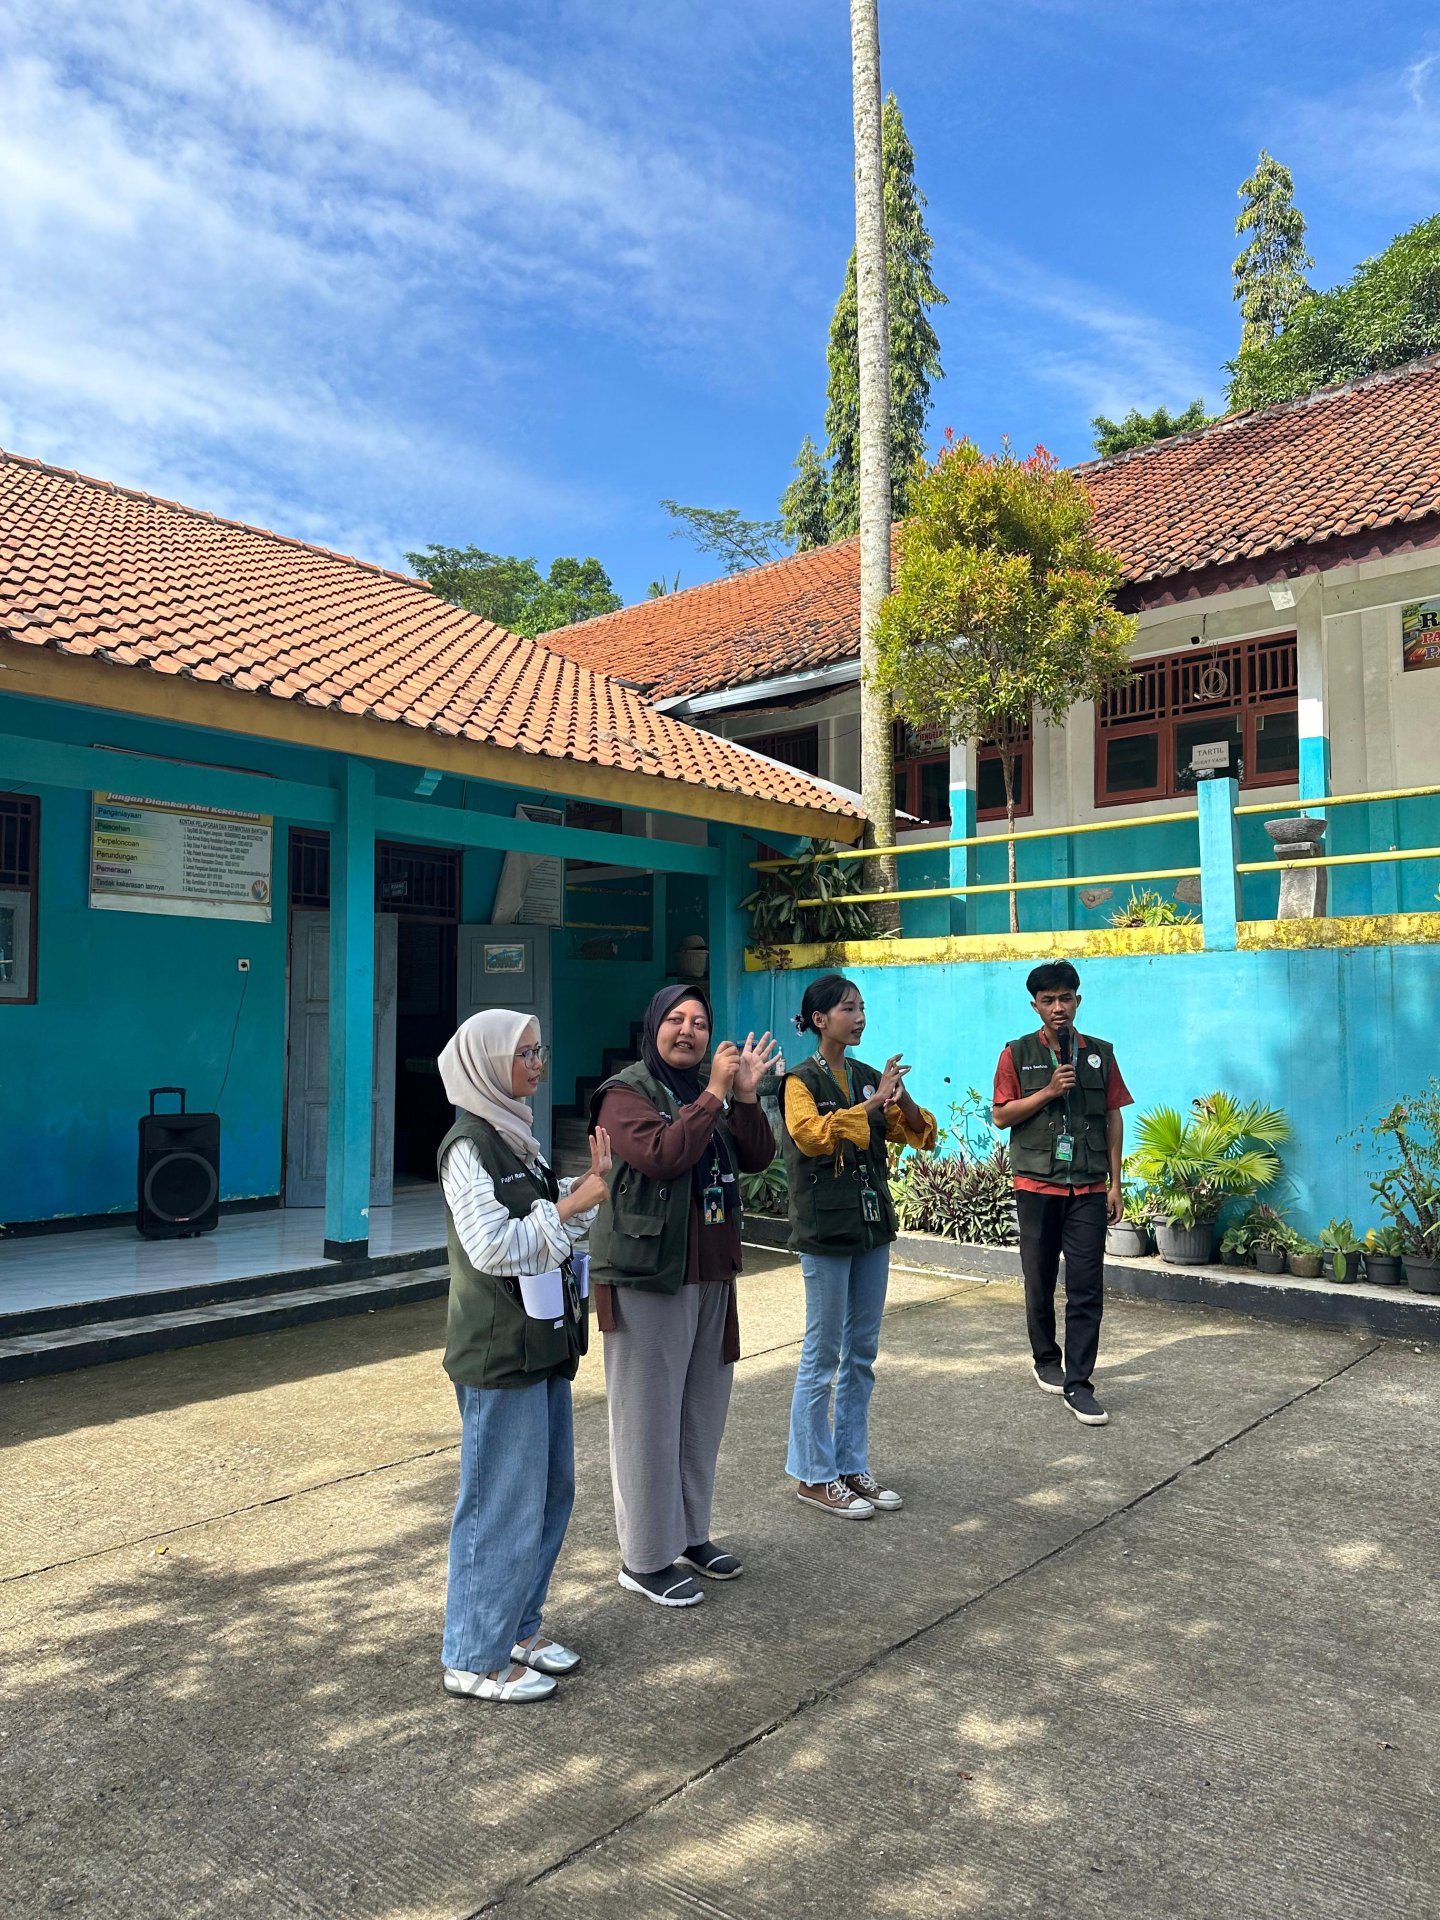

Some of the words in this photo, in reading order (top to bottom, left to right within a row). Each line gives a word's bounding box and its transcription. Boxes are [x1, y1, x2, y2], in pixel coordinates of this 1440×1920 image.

[1197, 747, 1224, 757] TARTIL
[107, 792, 144, 803] Jangan
[97, 836, 140, 847] Perpeloncoan
[96, 850, 138, 861] Perundungan
[96, 864, 132, 874] Pemerasan
[95, 878, 115, 887] Tindak
[116, 880, 144, 889] kekerasan
[145, 883, 165, 891] lainnya
